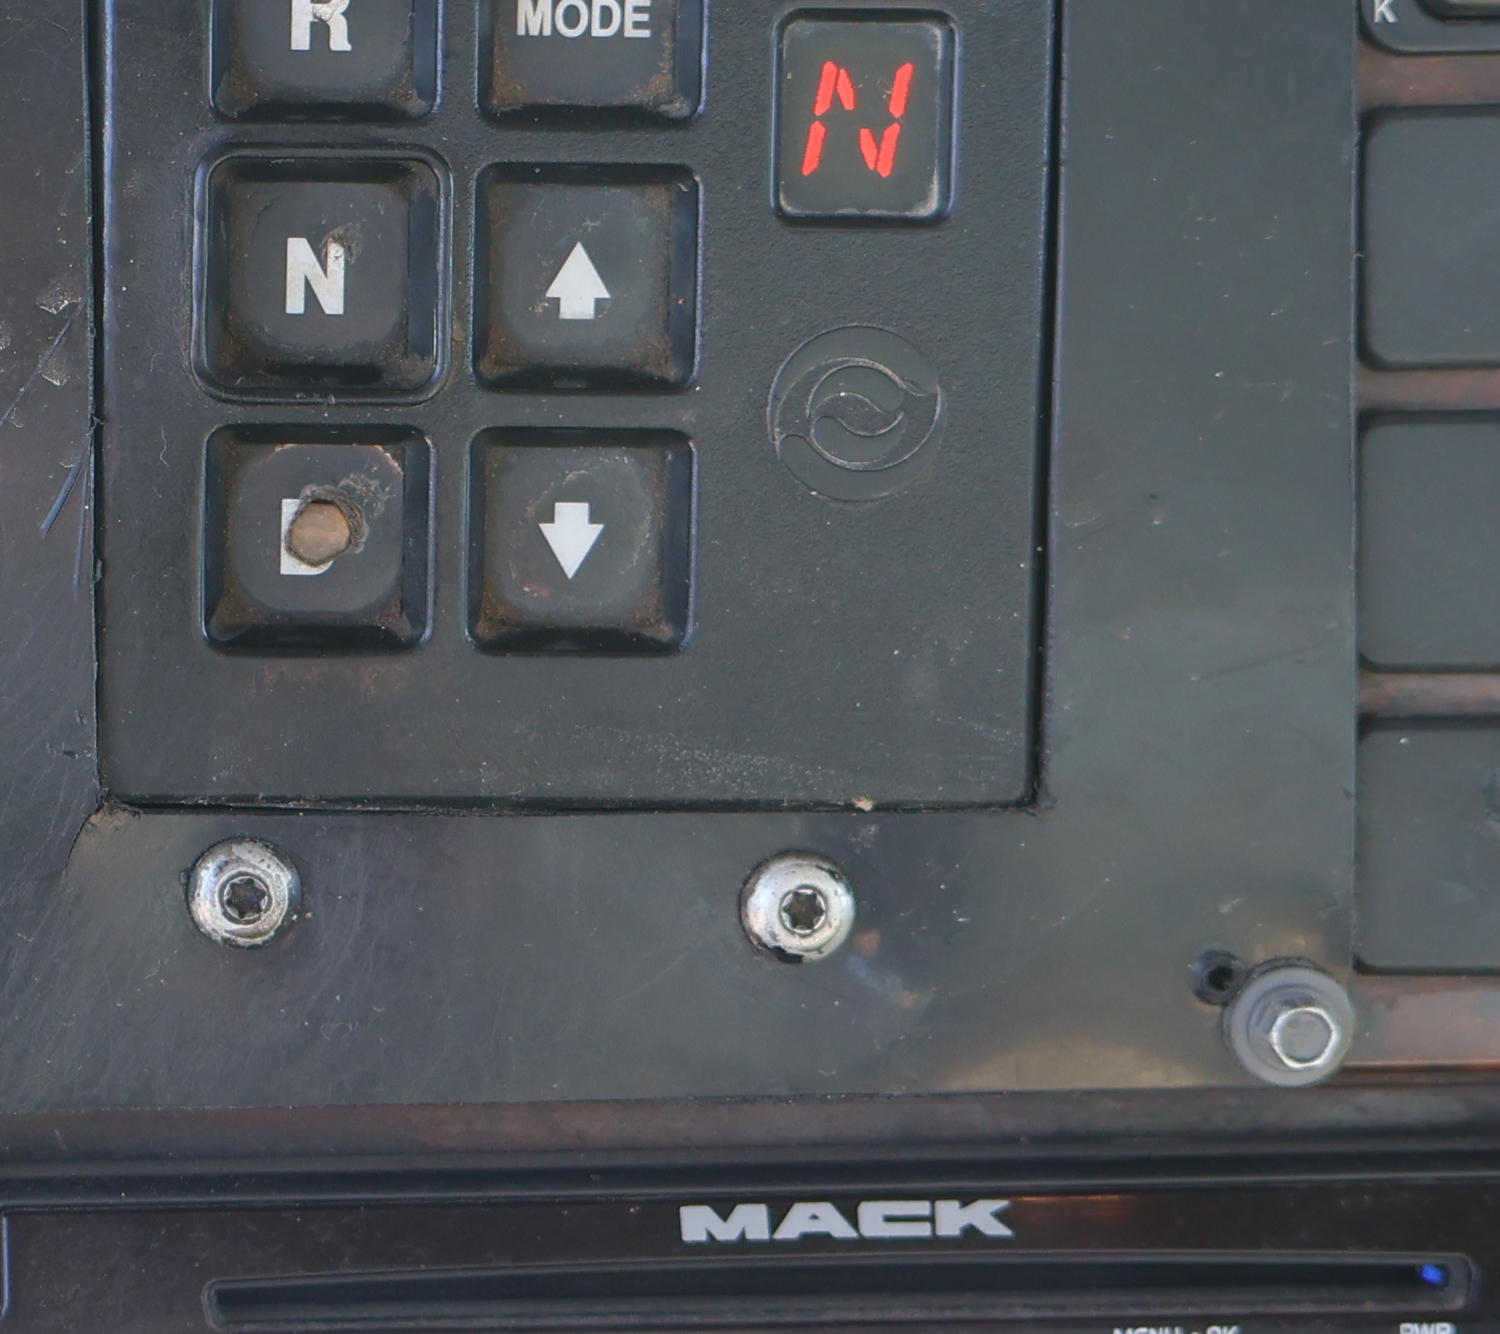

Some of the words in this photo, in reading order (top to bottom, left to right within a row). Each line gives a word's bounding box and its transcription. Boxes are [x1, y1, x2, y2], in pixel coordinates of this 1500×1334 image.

[801, 61, 914, 177] N
[284, 237, 345, 315] N
[677, 1198, 1014, 1239] MACK
